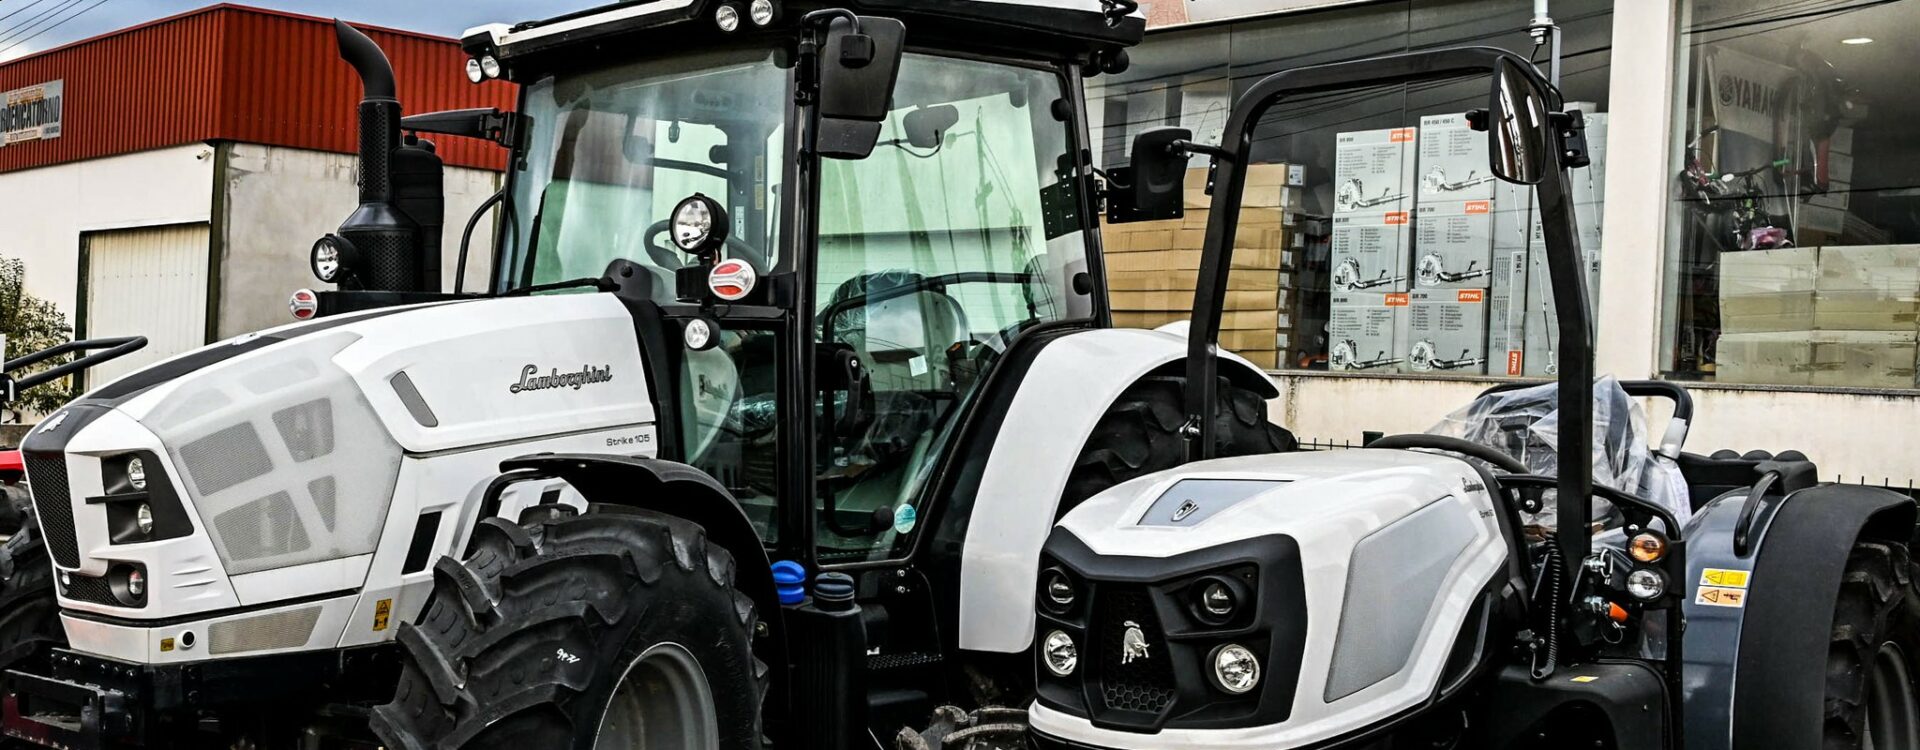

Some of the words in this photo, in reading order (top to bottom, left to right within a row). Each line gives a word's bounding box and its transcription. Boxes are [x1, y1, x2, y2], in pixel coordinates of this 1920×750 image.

[1510, 352, 1518, 374] STIHL
[510, 364, 613, 393] Lamborghini
[606, 435, 633, 446] Strike
[635, 434, 651, 444] 105
